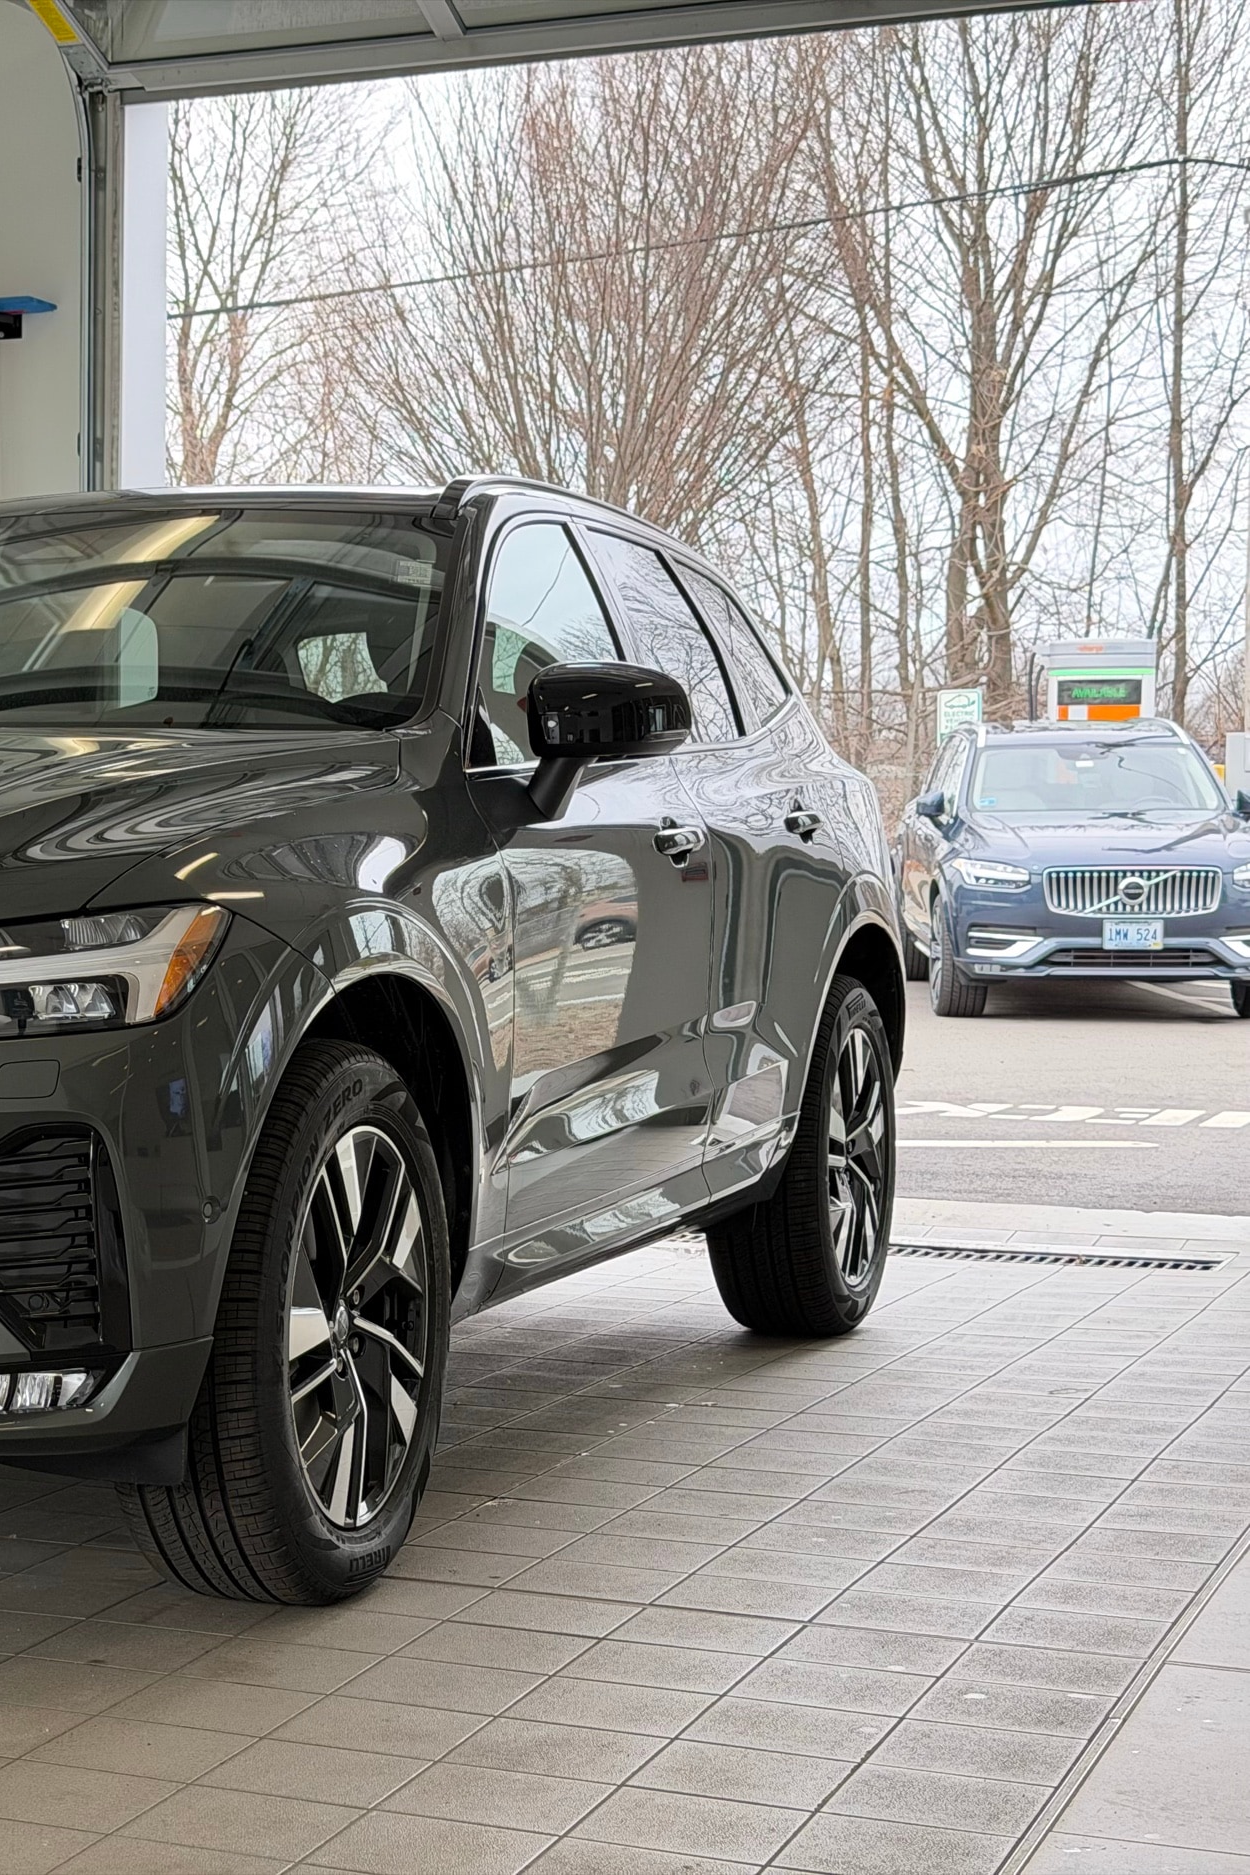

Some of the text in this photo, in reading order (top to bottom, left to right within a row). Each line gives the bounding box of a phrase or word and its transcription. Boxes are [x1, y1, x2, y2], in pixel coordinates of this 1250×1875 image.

[1072, 685, 1127, 698] AVAILABLE
[1136, 928, 1157, 941] 524
[324, 1078, 364, 1127] ZERO
